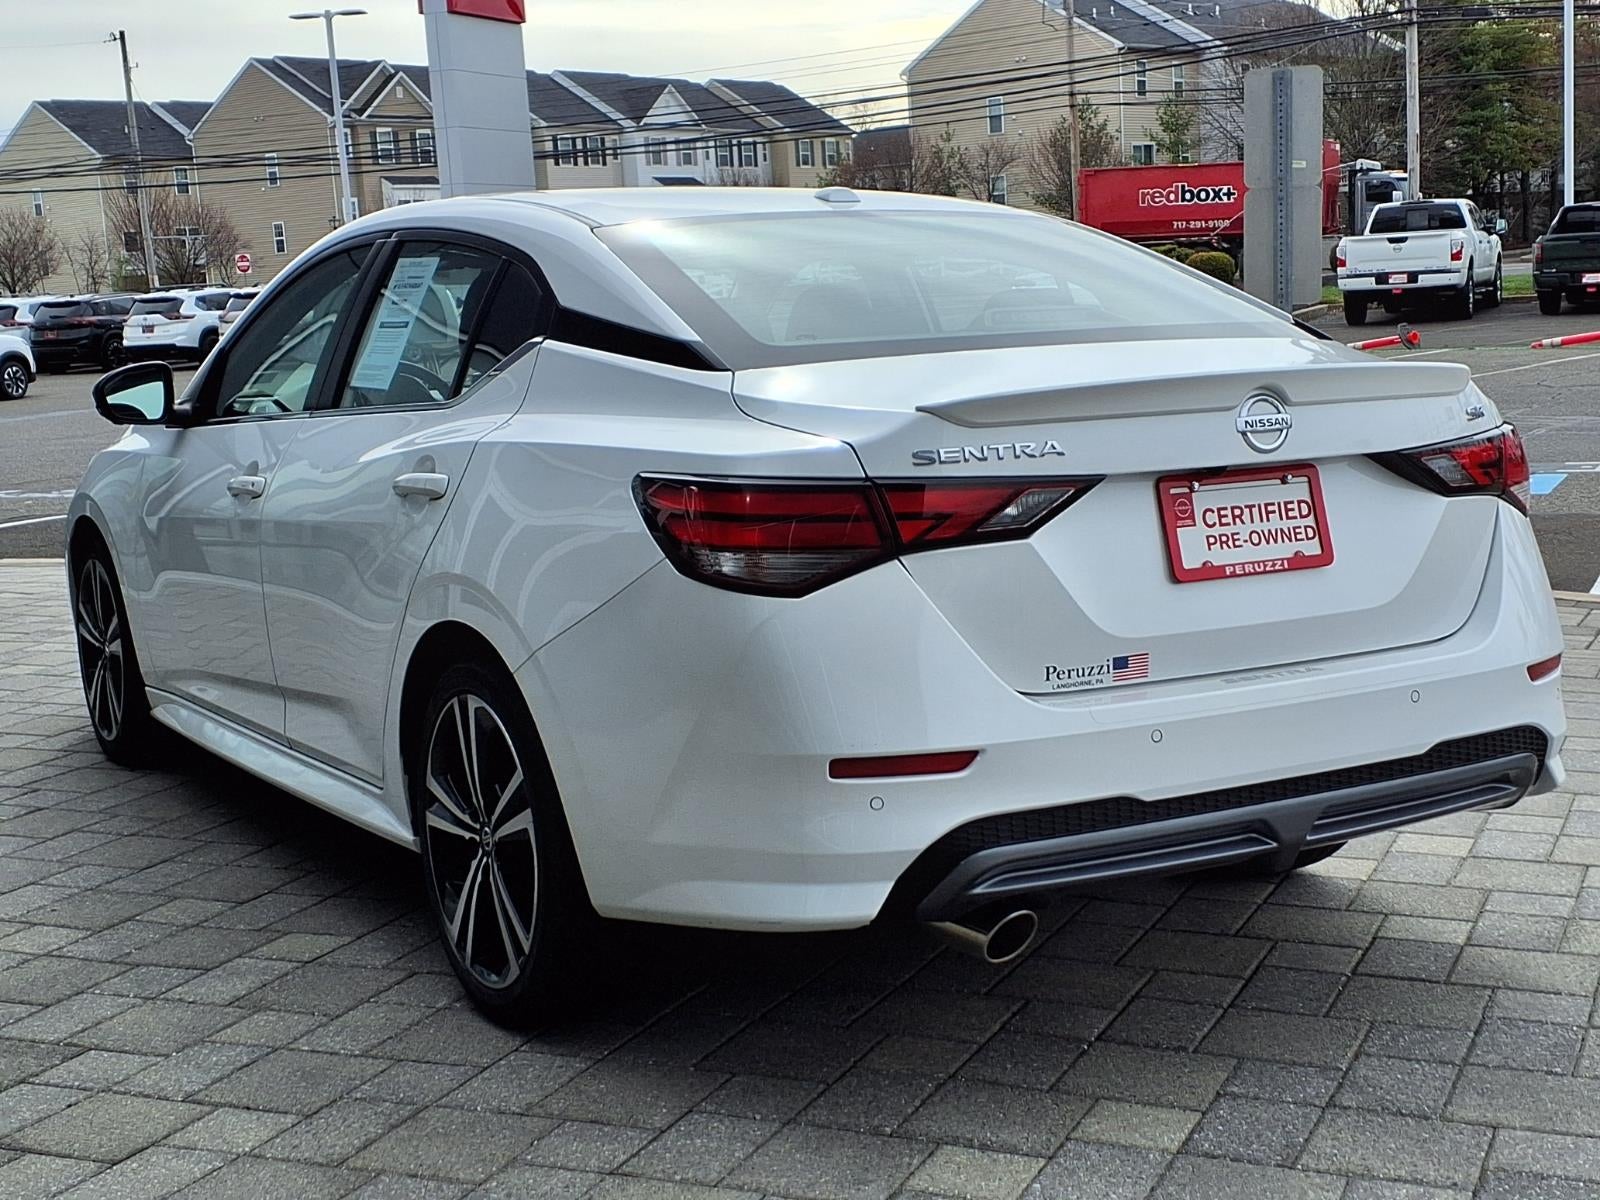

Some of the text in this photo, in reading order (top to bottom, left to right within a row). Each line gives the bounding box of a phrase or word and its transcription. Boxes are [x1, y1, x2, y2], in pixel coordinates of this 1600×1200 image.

[1139, 182, 1238, 206] redbox+
[1243, 416, 1290, 429] NISSAN
[911, 440, 1066, 466] SENTRA
[1202, 499, 1313, 529] CERTIFIED
[1206, 525, 1317, 551] PRE-OWNED
[1225, 560, 1288, 575] PERUZZI
[1044, 659, 1110, 681] Peruzzi
